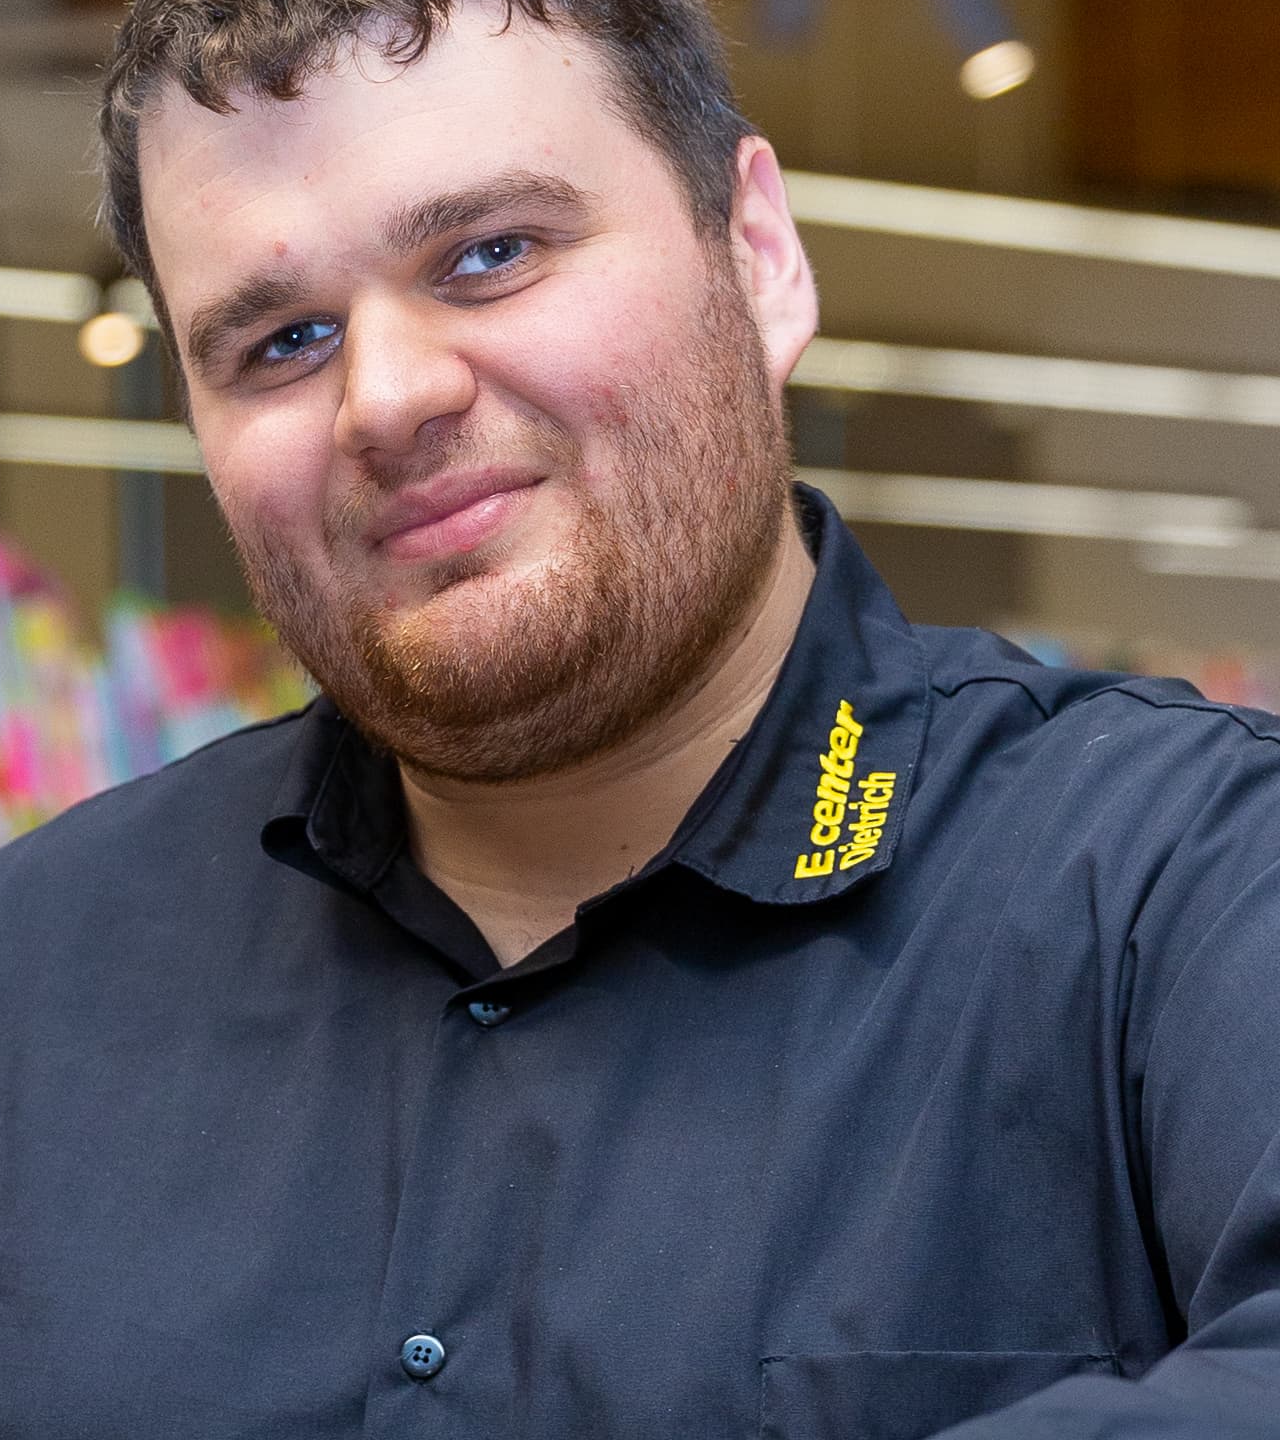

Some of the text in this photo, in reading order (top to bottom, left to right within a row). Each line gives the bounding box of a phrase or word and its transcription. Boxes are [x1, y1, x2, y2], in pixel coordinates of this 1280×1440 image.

[794, 699, 864, 879] E center
[838, 772, 896, 870] Dietrich
